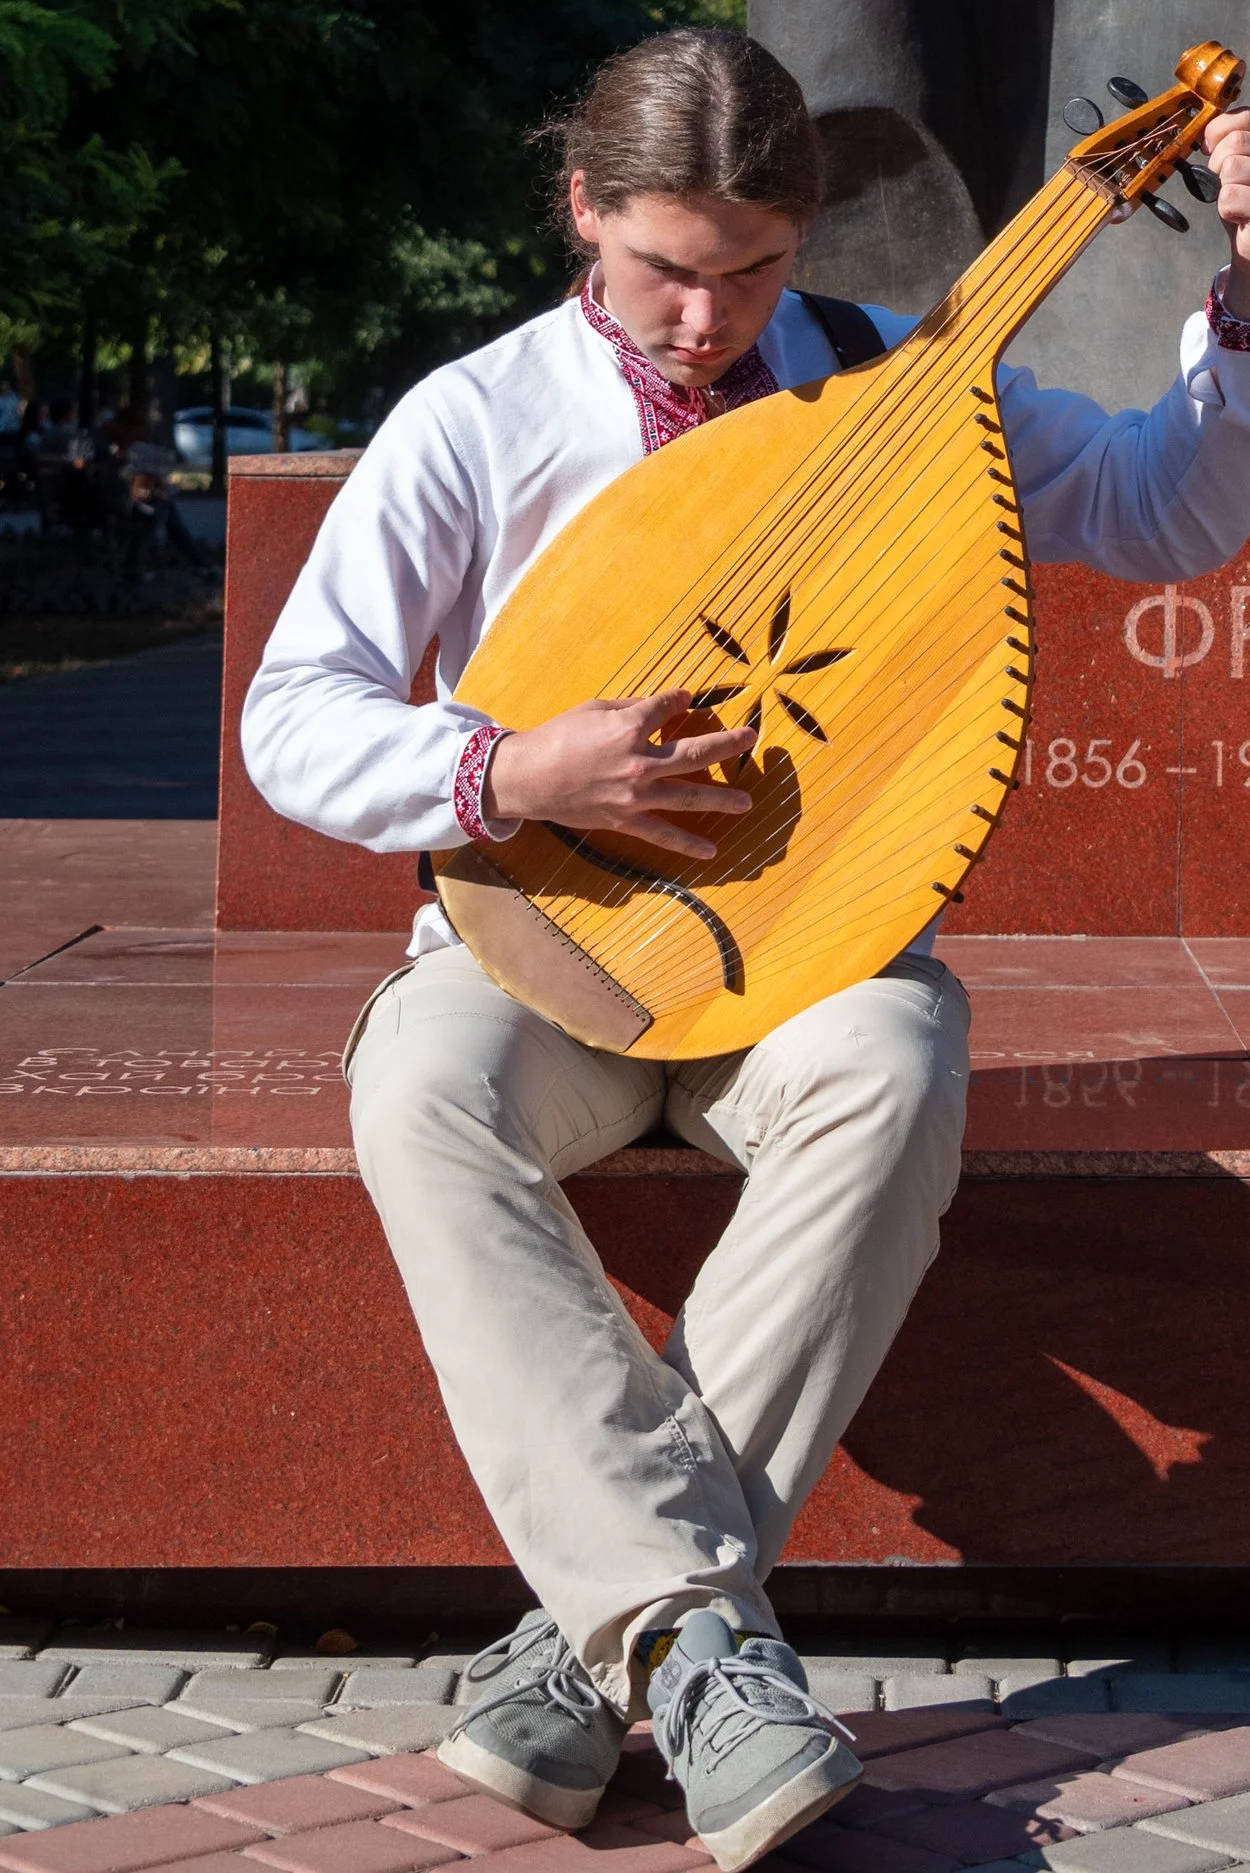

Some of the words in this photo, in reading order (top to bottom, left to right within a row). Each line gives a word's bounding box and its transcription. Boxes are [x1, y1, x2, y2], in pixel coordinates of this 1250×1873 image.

[1023, 737, 1148, 790] 1856
[90, 1058, 344, 1070] товар
[2, 1069, 169, 1081] Хай
